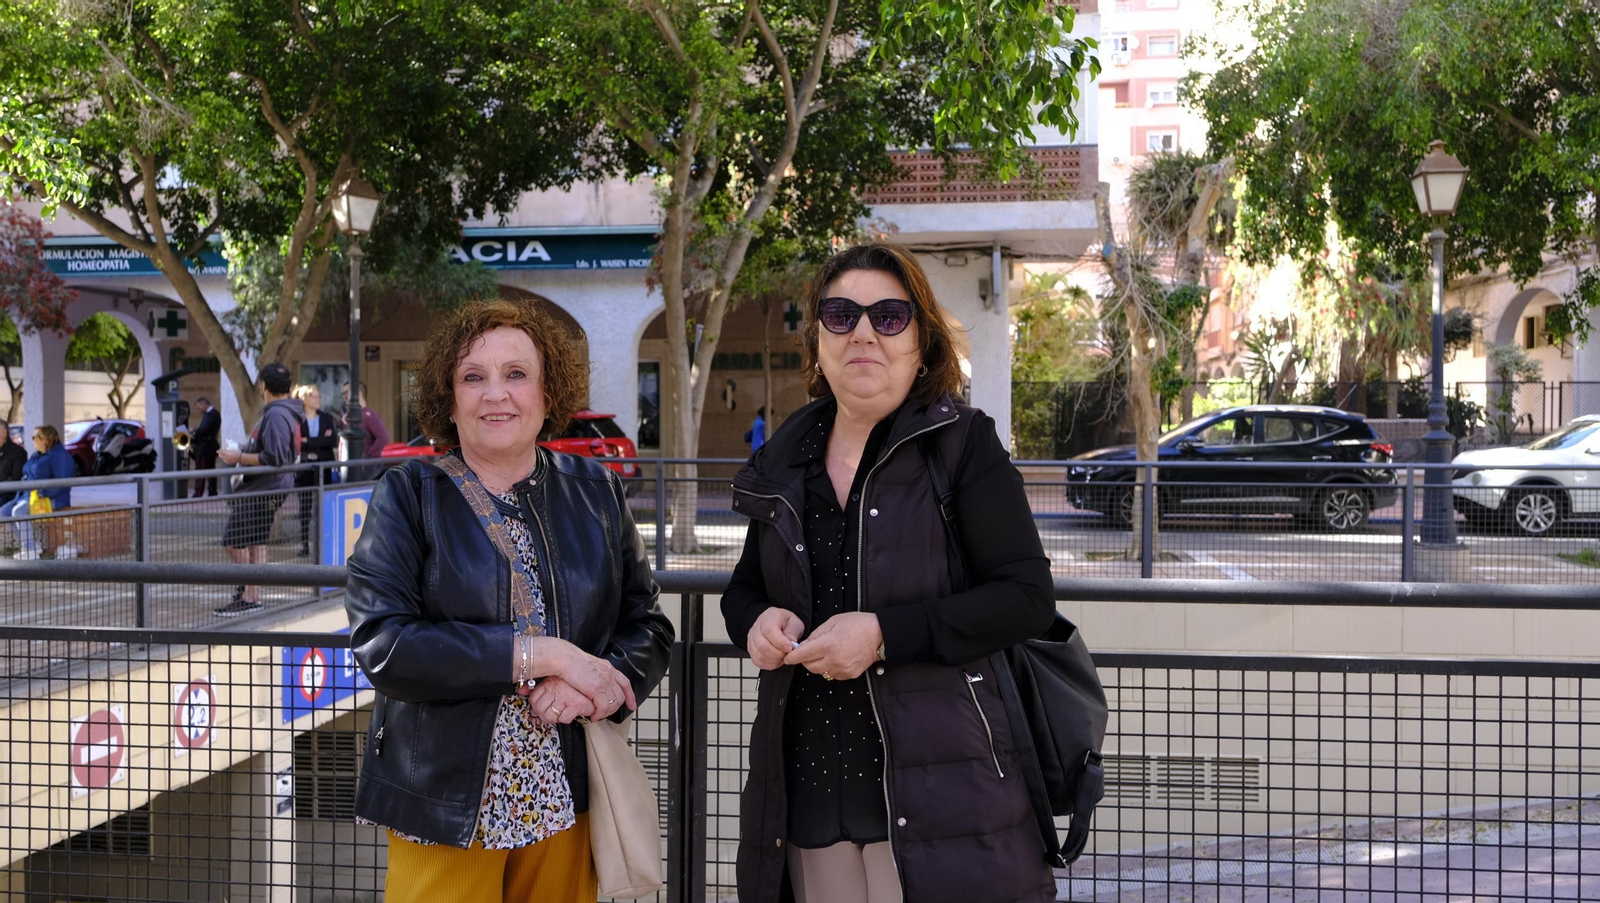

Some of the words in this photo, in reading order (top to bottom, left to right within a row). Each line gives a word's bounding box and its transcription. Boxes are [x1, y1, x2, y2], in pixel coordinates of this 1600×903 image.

[39, 248, 103, 260] ORMULACION
[108, 247, 150, 259] MAGIST
[445, 239, 552, 262] ACIA
[66, 259, 130, 271] HOMEOPATIA
[169, 381, 178, 392] P
[344, 498, 369, 566] P
